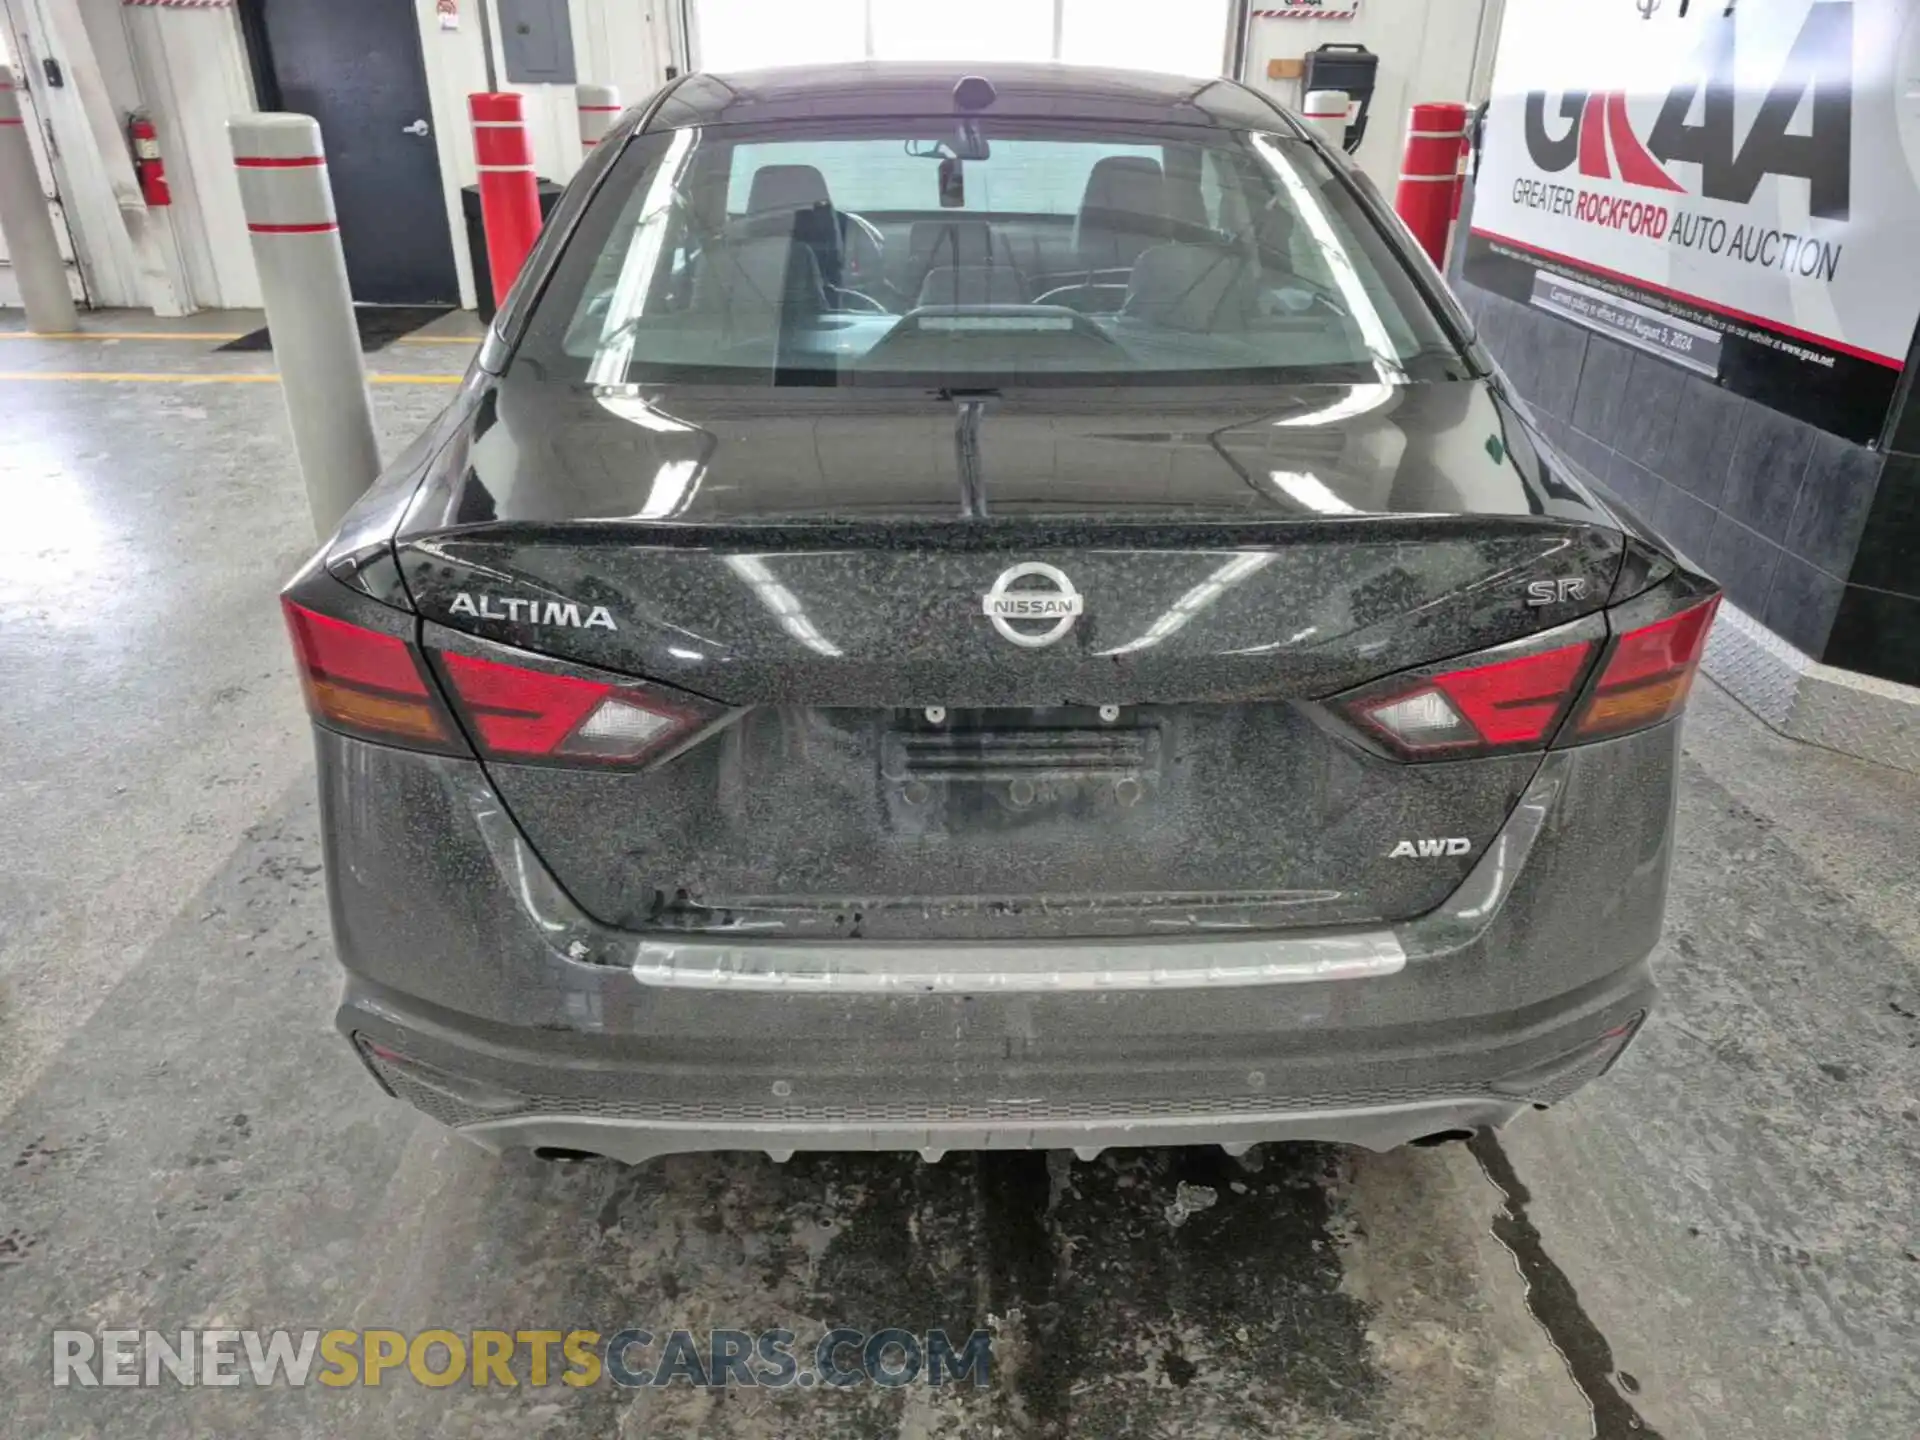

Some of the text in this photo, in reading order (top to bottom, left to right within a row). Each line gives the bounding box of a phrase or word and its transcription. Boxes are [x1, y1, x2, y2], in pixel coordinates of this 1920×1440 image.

[1512, 178, 1843, 282] GREATER ROCKFORD AUTO AUCTION
[1634, 319, 1660, 340] August
[1670, 331, 1694, 352] 2024
[994, 600, 1073, 614] NISSAN
[1527, 578, 1585, 607] SR
[449, 592, 618, 631] ALTIMA
[1388, 838, 1471, 858] AWD
